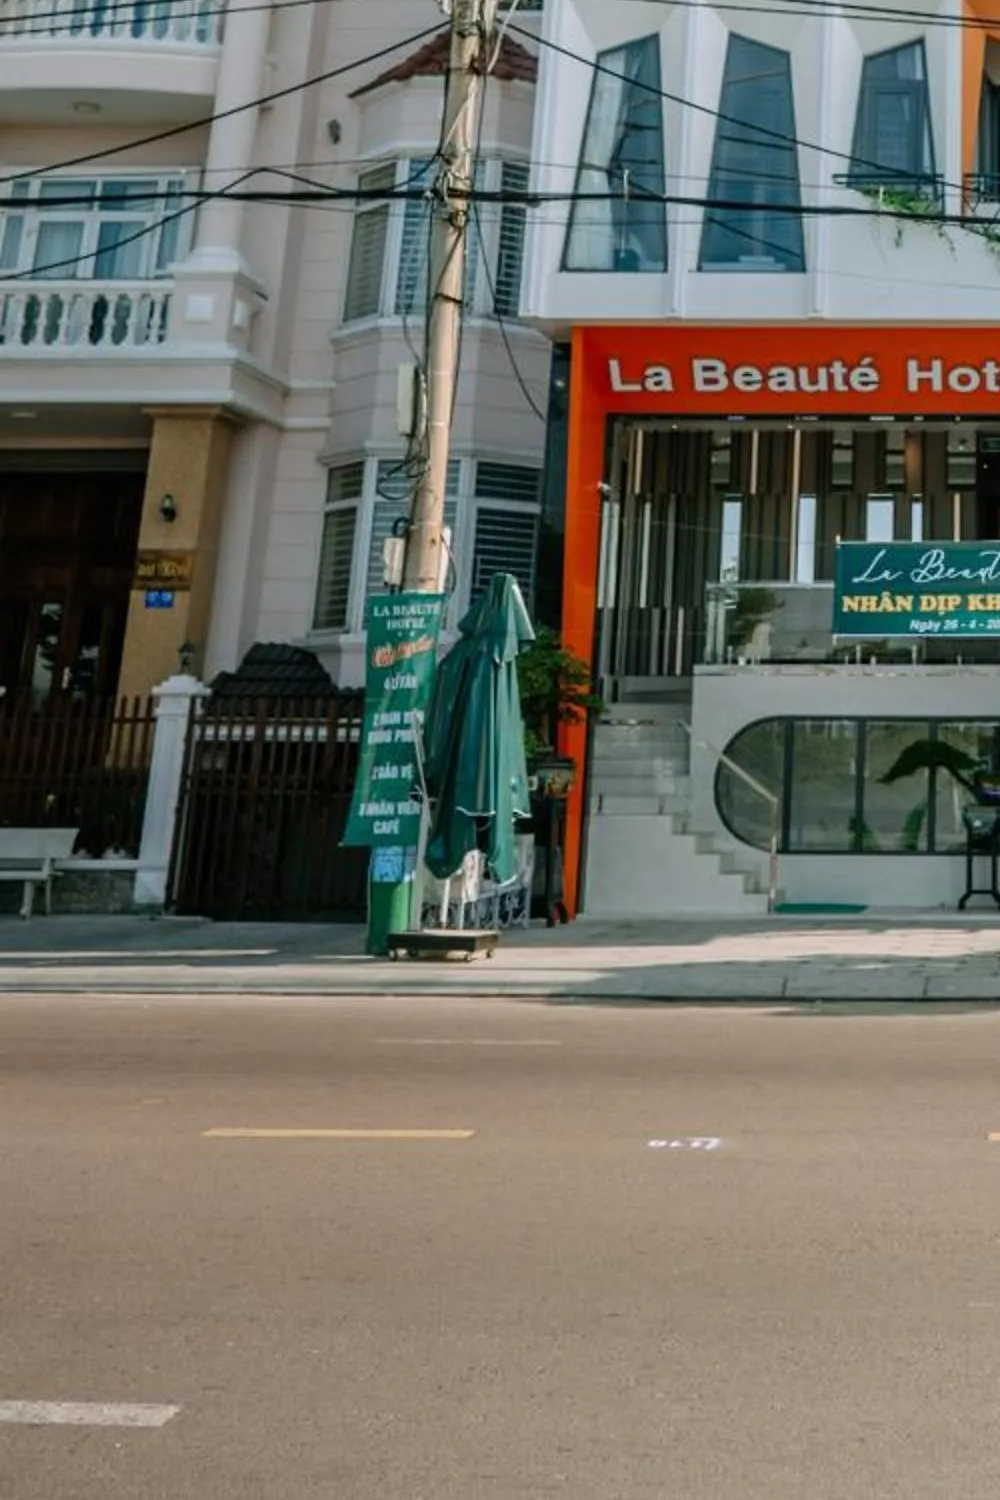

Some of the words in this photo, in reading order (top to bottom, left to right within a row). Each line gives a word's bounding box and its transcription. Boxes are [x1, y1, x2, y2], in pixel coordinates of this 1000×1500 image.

[608, 359, 673, 393] La
[692, 357, 880, 393] Beauté
[852, 549, 903, 583] La
[842, 592, 913, 612] NHÂN
[920, 594, 961, 616] DỊP
